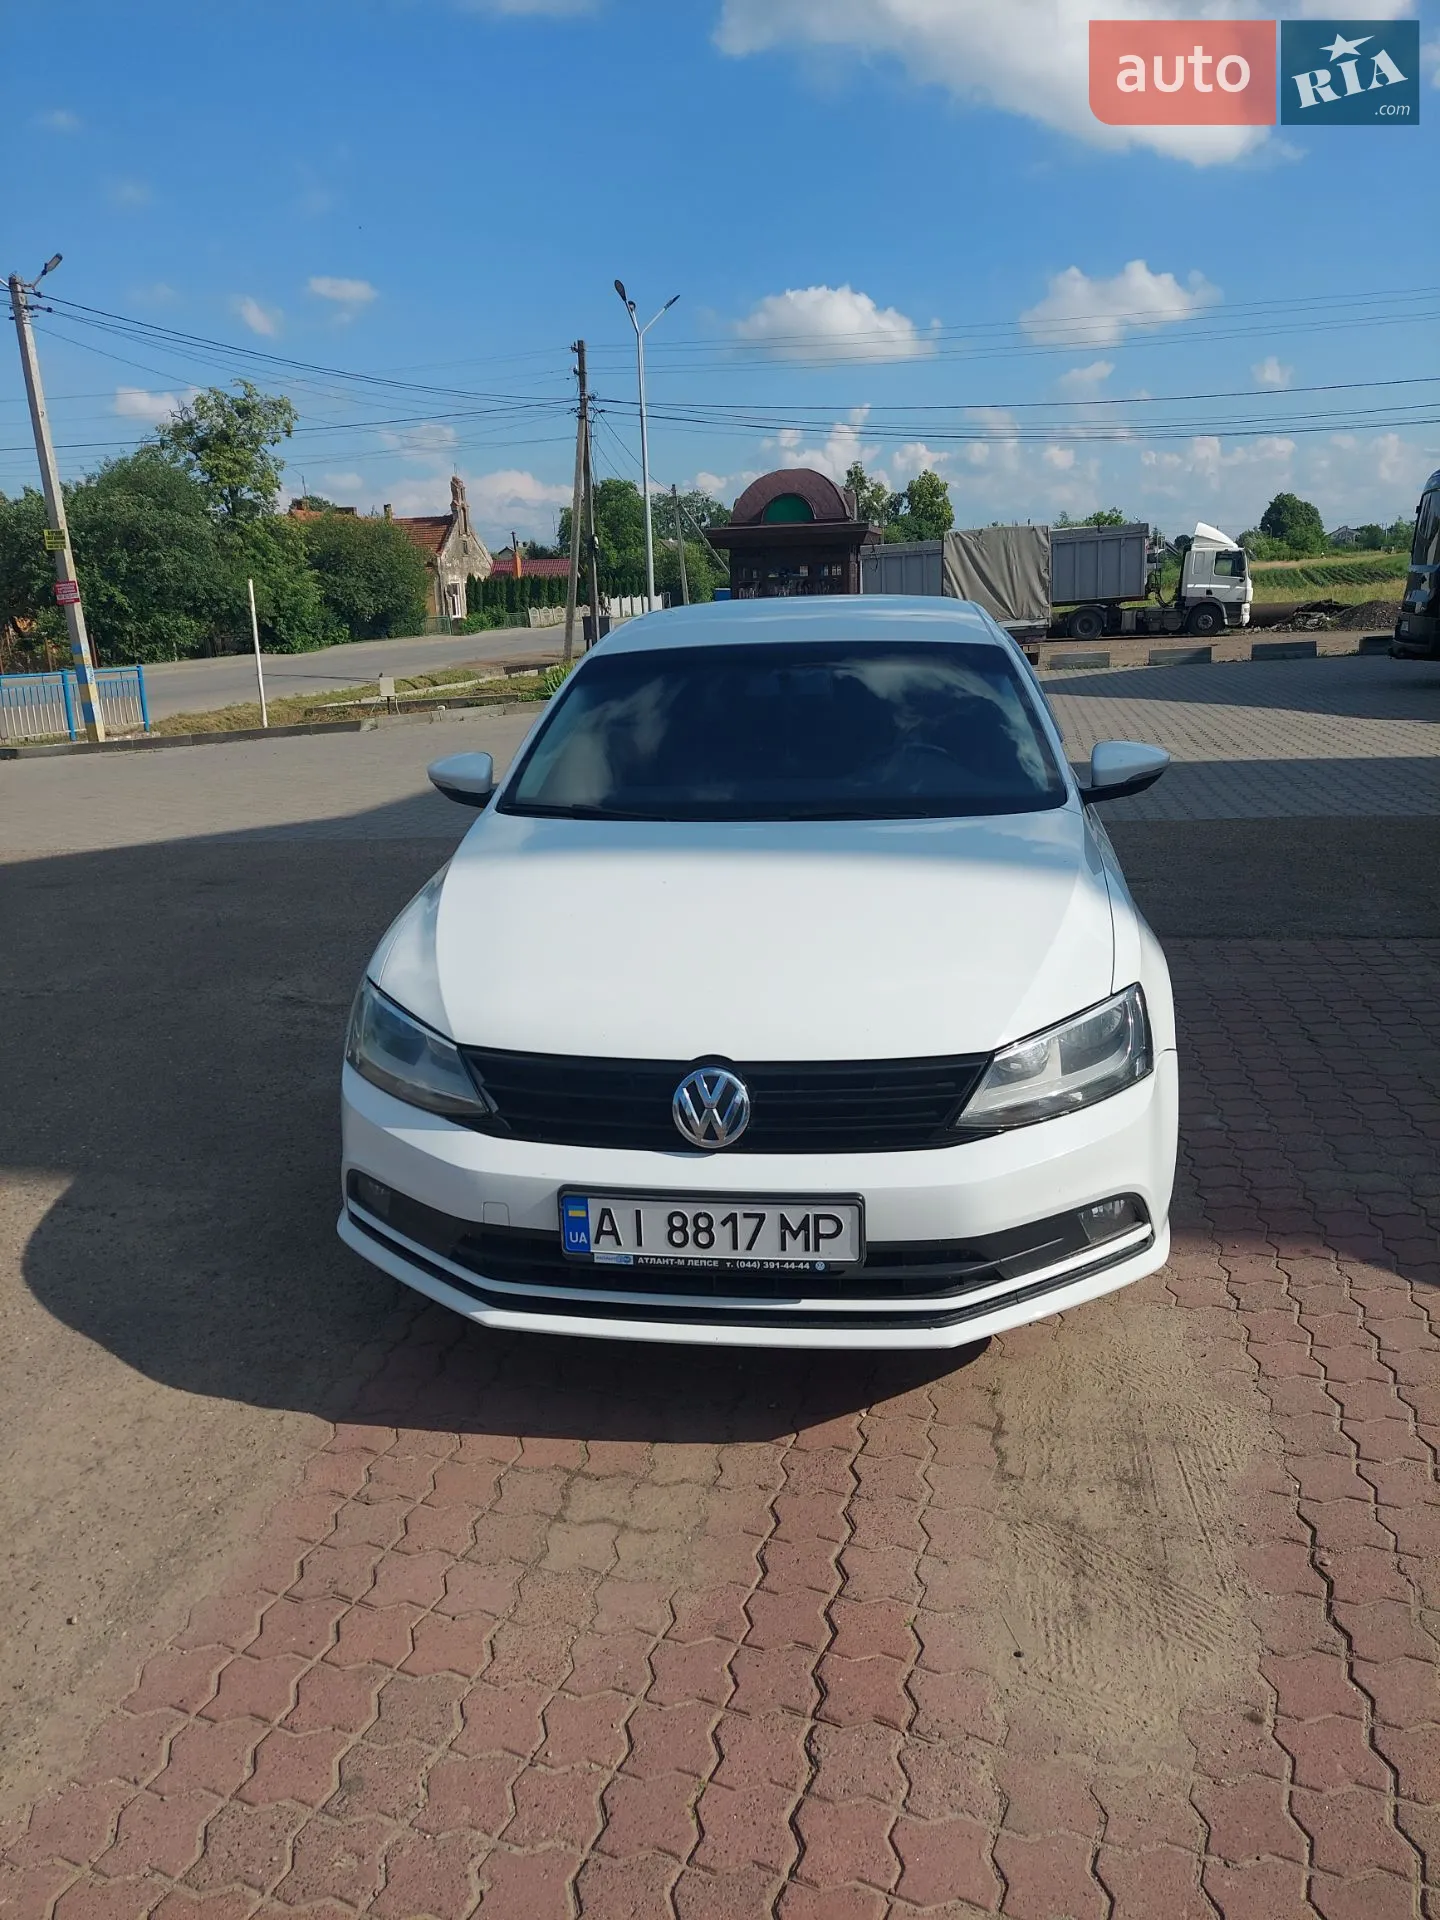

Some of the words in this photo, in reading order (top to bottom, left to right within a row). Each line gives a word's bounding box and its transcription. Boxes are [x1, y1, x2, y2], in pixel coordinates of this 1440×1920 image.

[674, 1068, 749, 1147] VW
[569, 1231, 588, 1244] UA
[594, 1207, 643, 1248] AI
[666, 1210, 767, 1251] 8817
[780, 1212, 844, 1252] MP
[637, 1256, 685, 1266] АТЛАНТ-М
[687, 1259, 719, 1267] ЛЕПСЕ
[736, 1260, 761, 1269] (044)
[763, 1261, 810, 1270] 391-44-44
